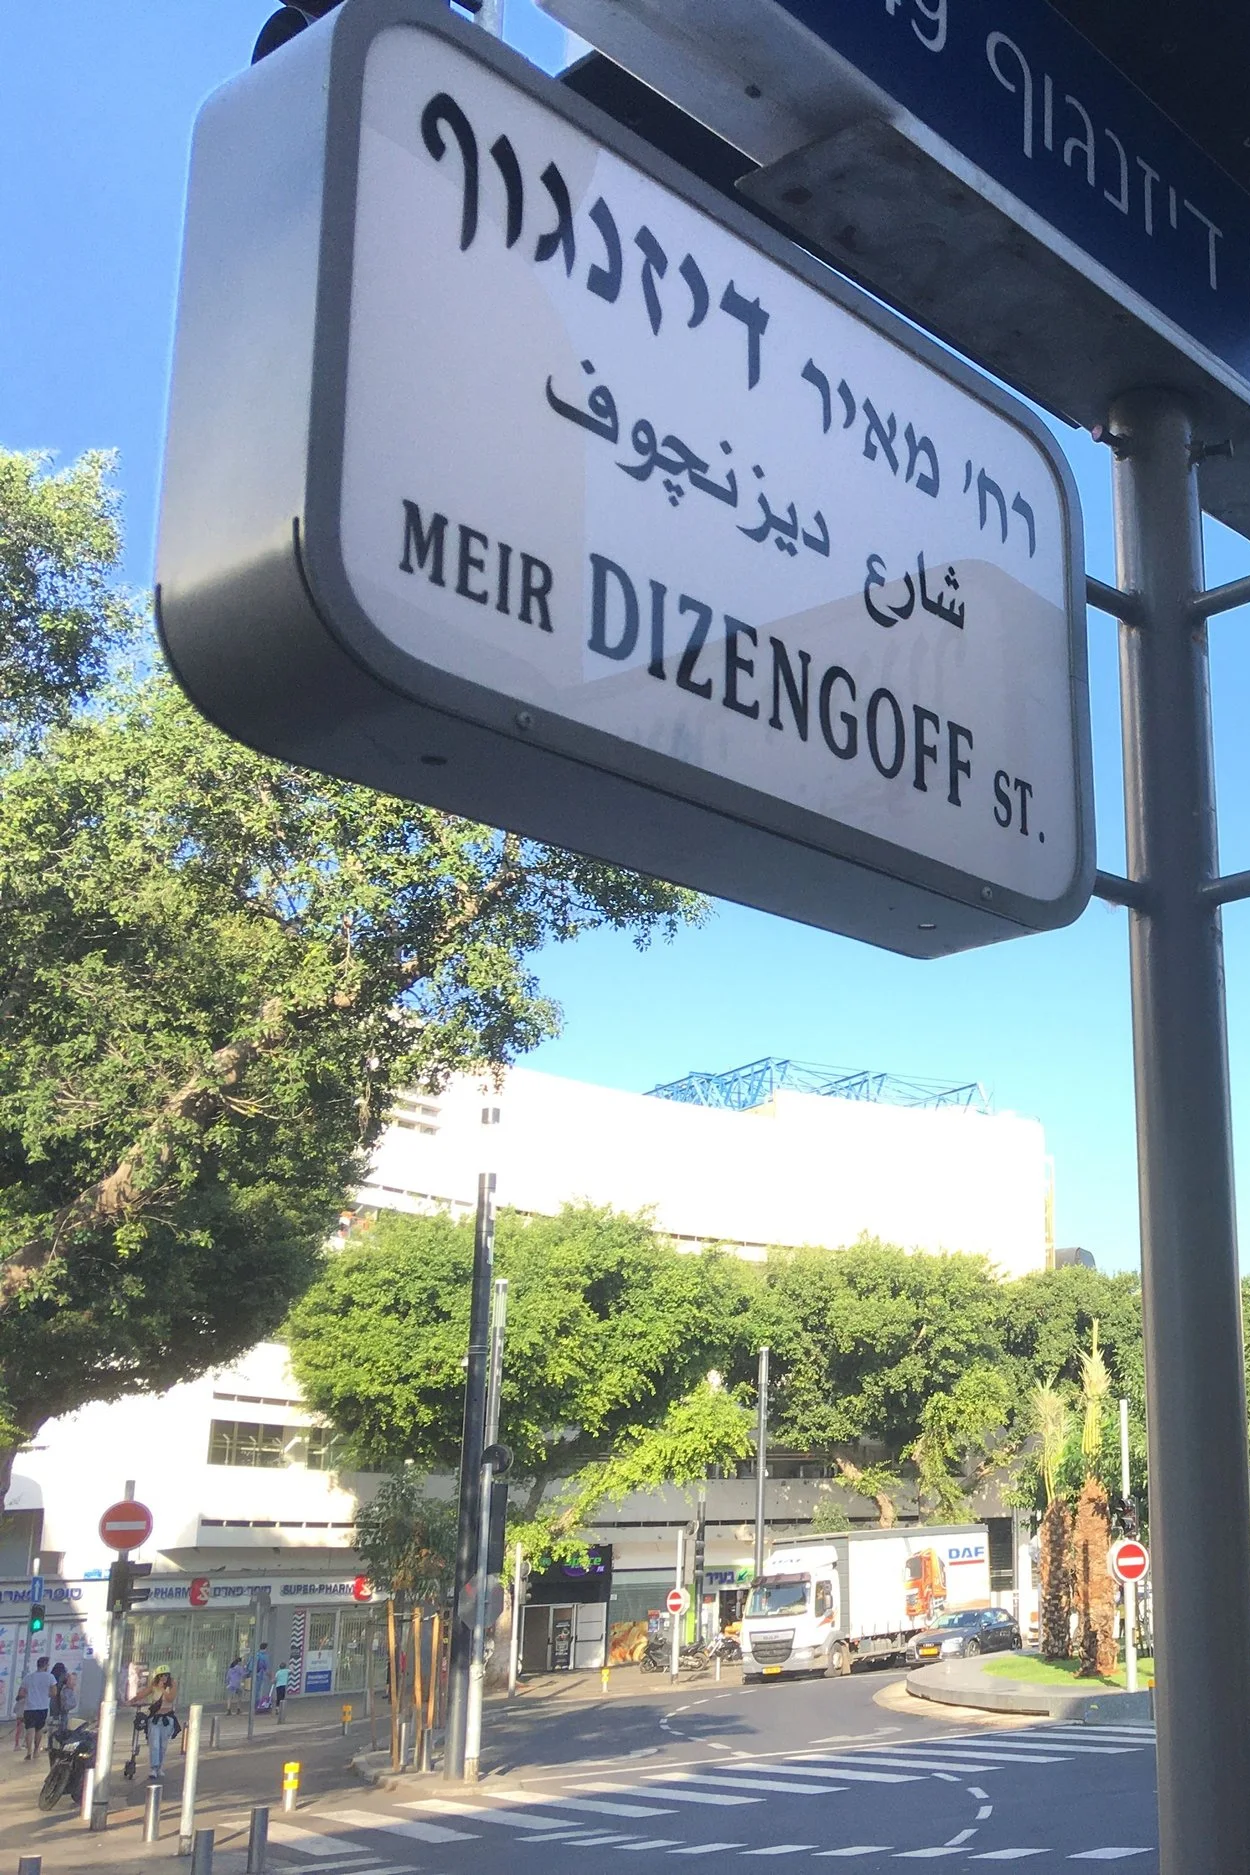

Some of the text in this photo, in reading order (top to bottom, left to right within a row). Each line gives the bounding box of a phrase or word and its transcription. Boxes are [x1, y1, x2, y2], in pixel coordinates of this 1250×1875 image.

[985, 31, 1224, 290] דיזנגוף
[421, 91, 770, 391] דיזנגוף
[801, 358, 941, 498] מאיר
[864, 551, 967, 630] شارع
[399, 498, 1046, 844] MEIR DIZENGOFF ST.
[283, 1583, 355, 1595] SUPER-PHARM
[949, 1546, 985, 1559] DAF
